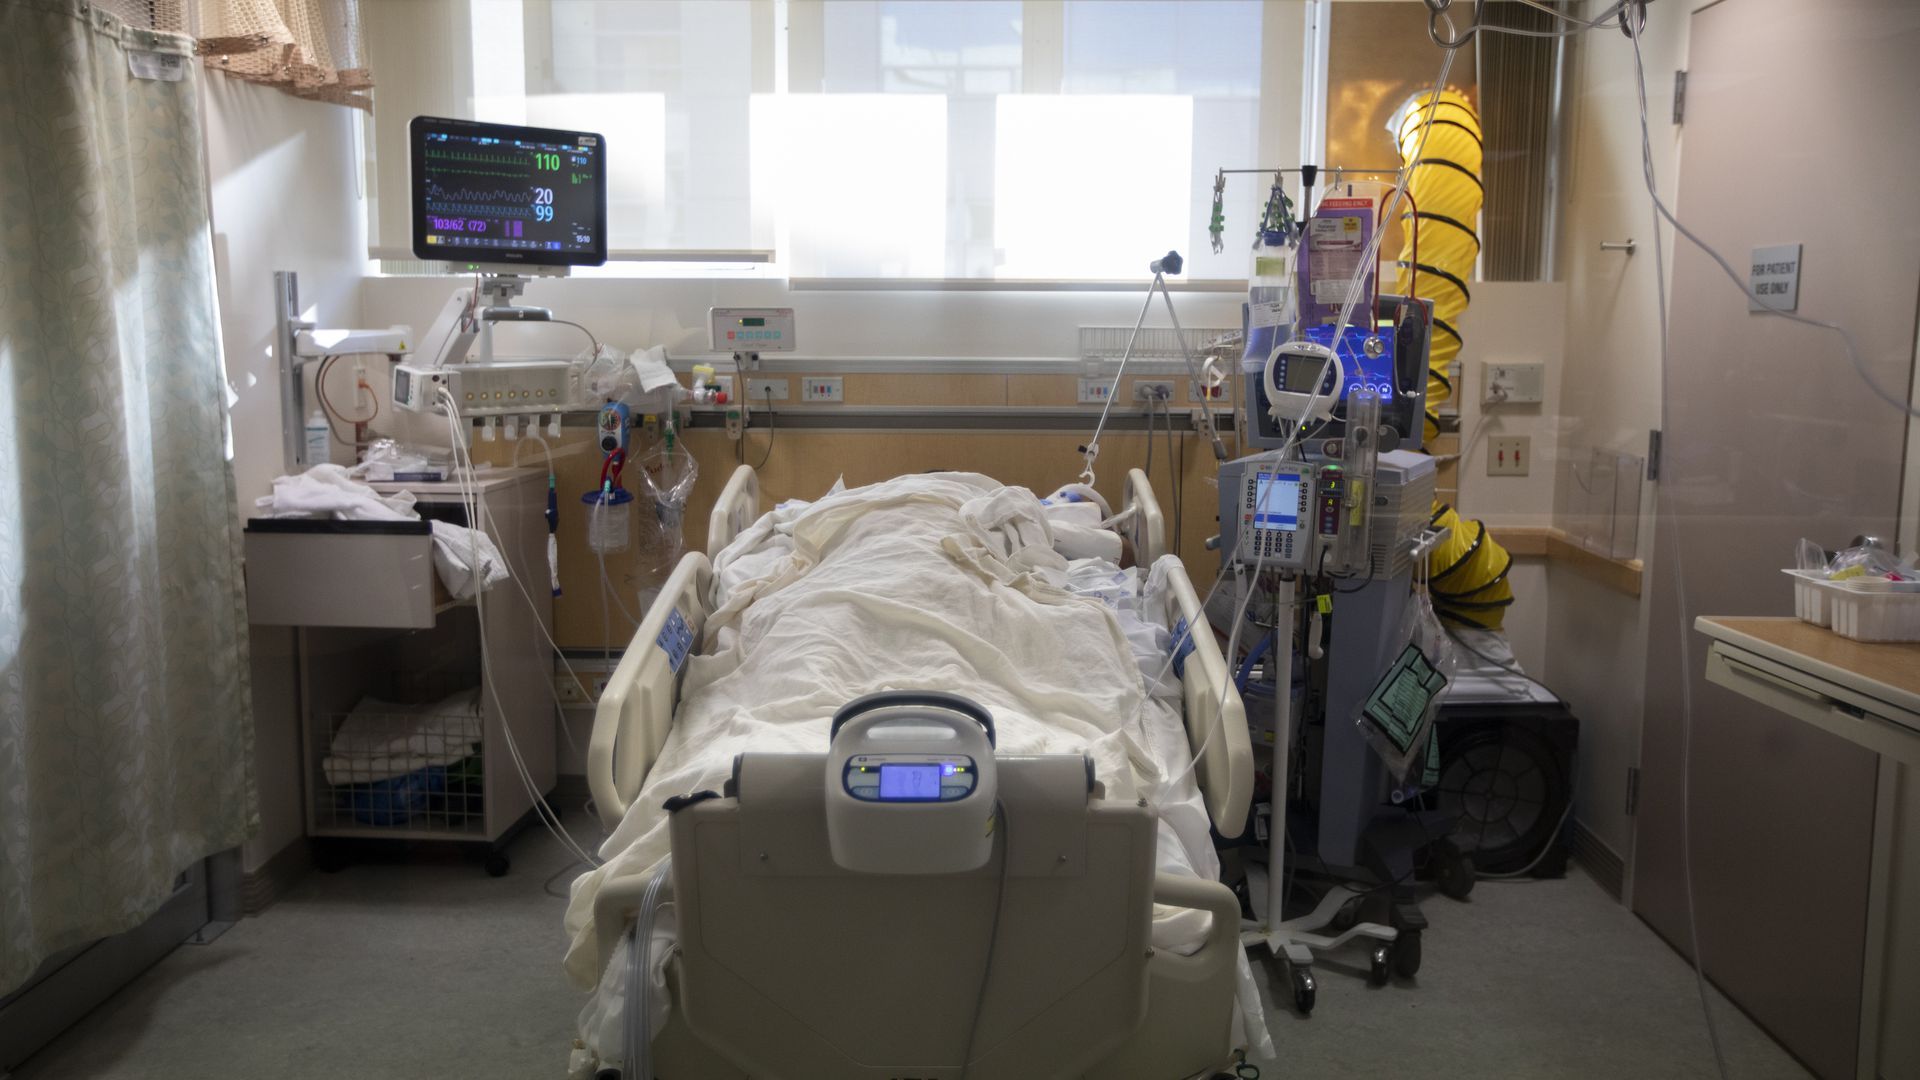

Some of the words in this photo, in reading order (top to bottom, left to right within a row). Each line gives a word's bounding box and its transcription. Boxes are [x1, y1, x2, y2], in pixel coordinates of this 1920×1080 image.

[535, 152, 561, 171] 110
[576, 156, 588, 165] 110
[535, 187, 553, 205] 20
[535, 205, 554, 222] 99
[433, 218, 464, 231] 103/62
[468, 219, 487, 233] (72)
[1752, 264, 1765, 276] FOR
[1767, 262, 1796, 274] PATIENT
[1756, 283, 1768, 294] USE
[1771, 282, 1789, 294] ONLY
